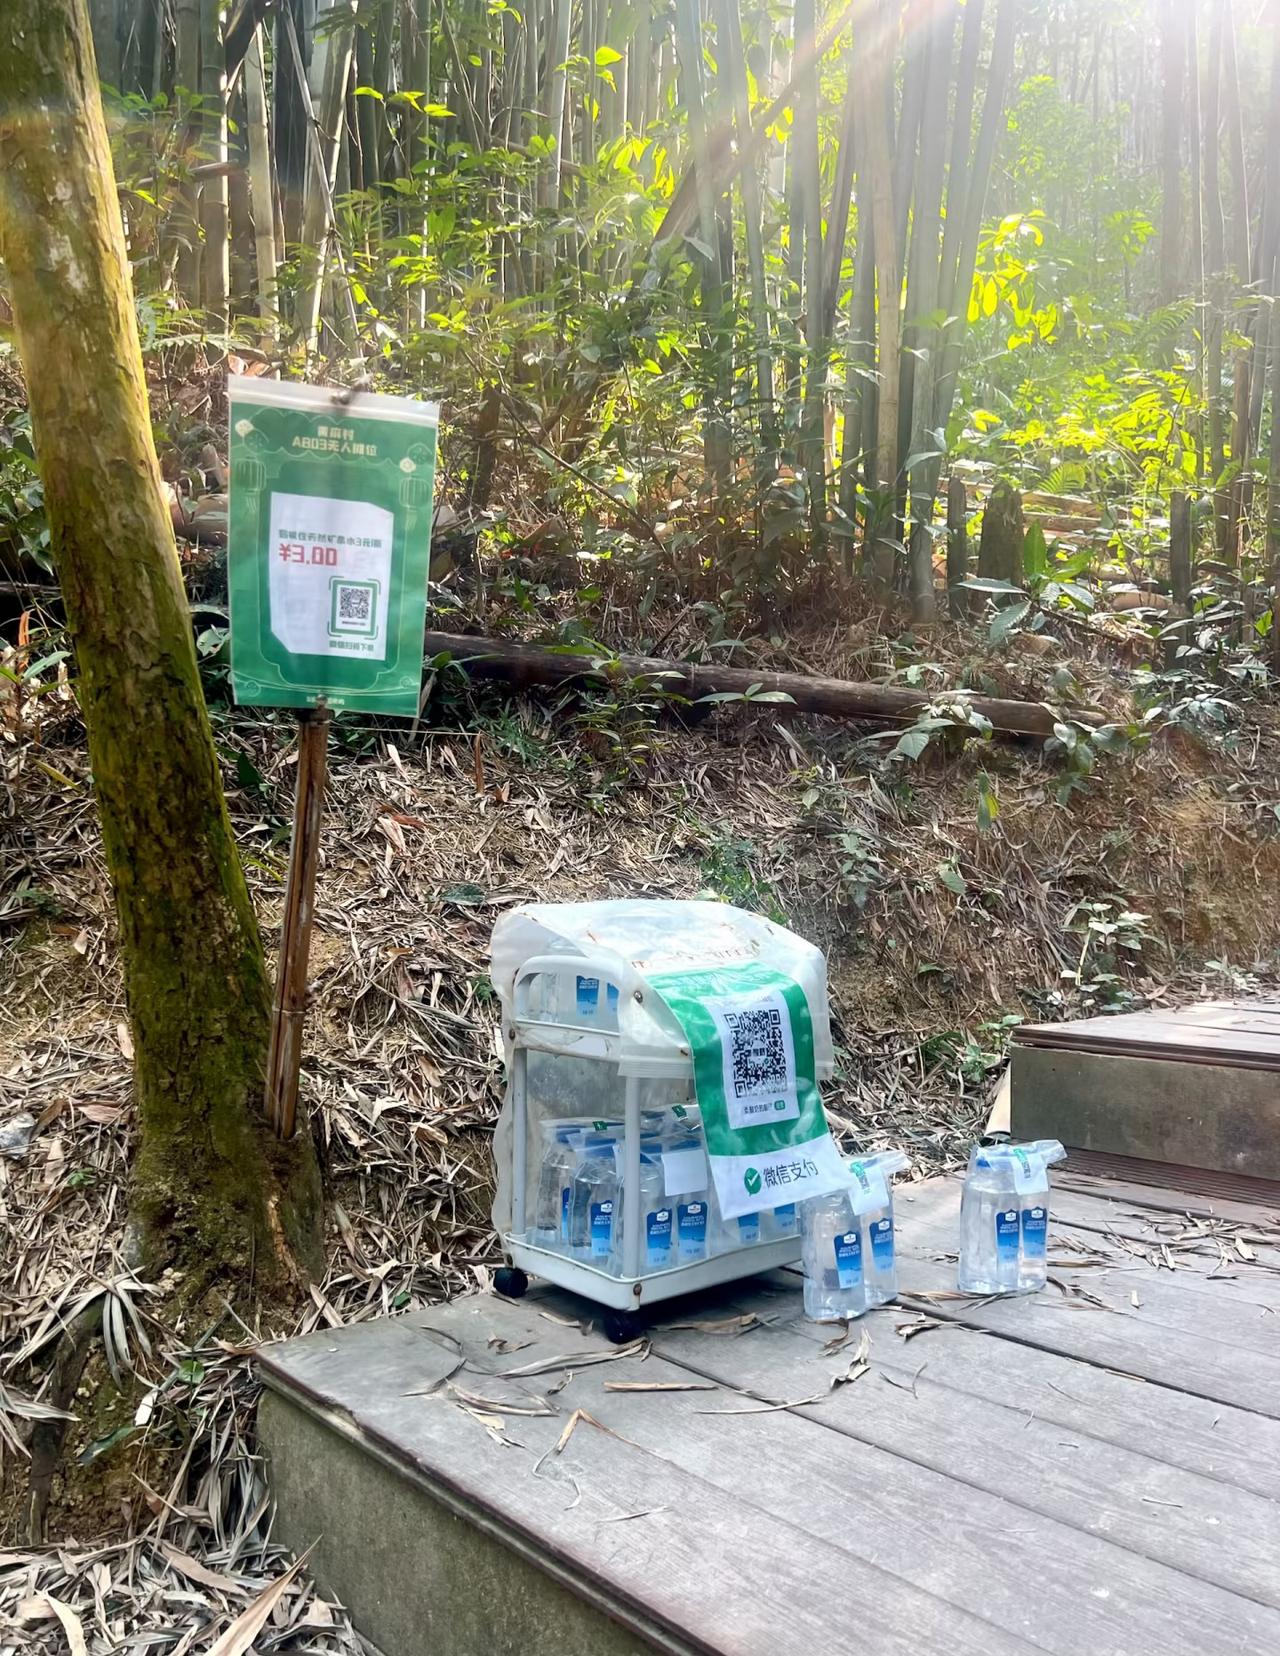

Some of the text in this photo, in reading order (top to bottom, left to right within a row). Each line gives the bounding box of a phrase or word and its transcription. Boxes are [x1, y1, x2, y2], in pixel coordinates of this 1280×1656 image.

[279, 543, 338, 566] ¥3.00
[762, 1158, 819, 1189] 微信支付
